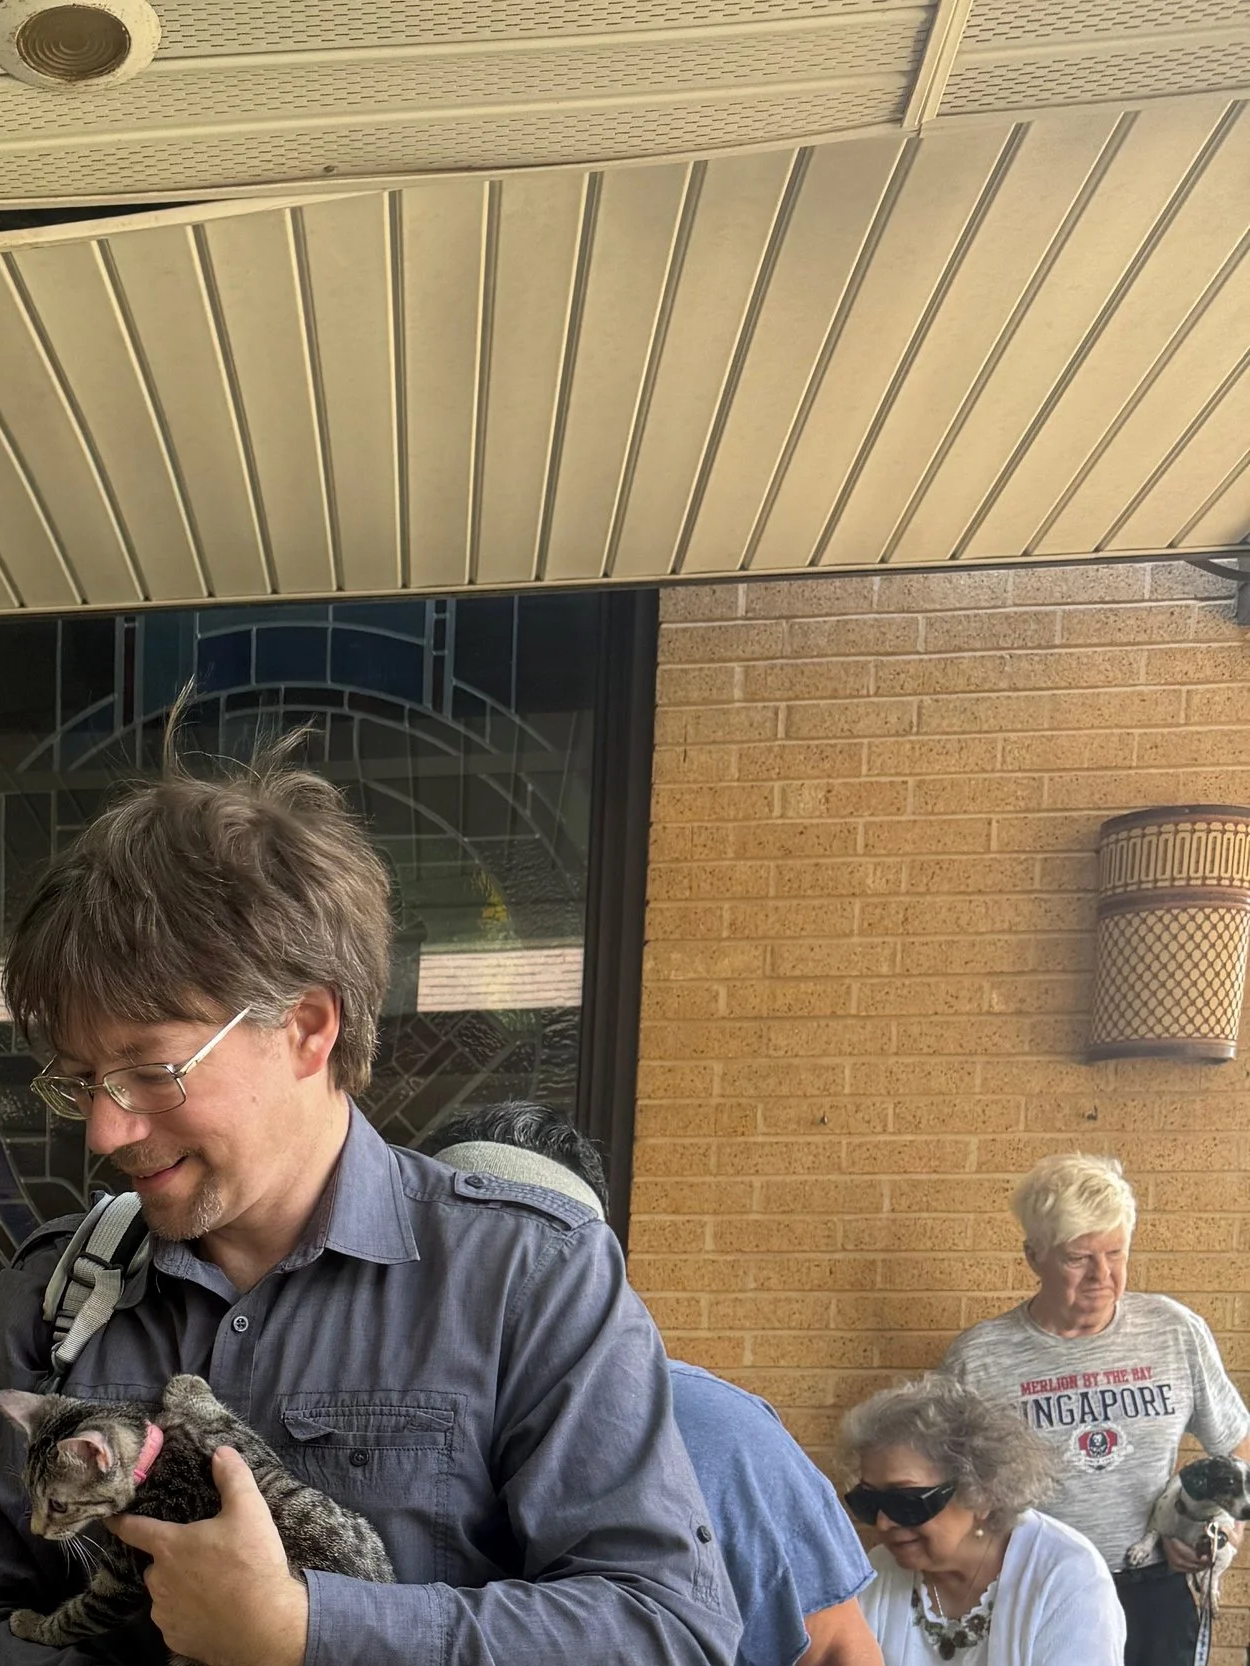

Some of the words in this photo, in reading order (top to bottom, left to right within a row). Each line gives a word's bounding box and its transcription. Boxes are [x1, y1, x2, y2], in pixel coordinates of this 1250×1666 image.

[1020, 1376, 1078, 1396] MERLION
[1083, 1373, 1100, 1390] BY
[1103, 1368, 1129, 1384] THE
[1132, 1366, 1153, 1382] BAY
[1020, 1384, 1175, 1428] INGAPORE
